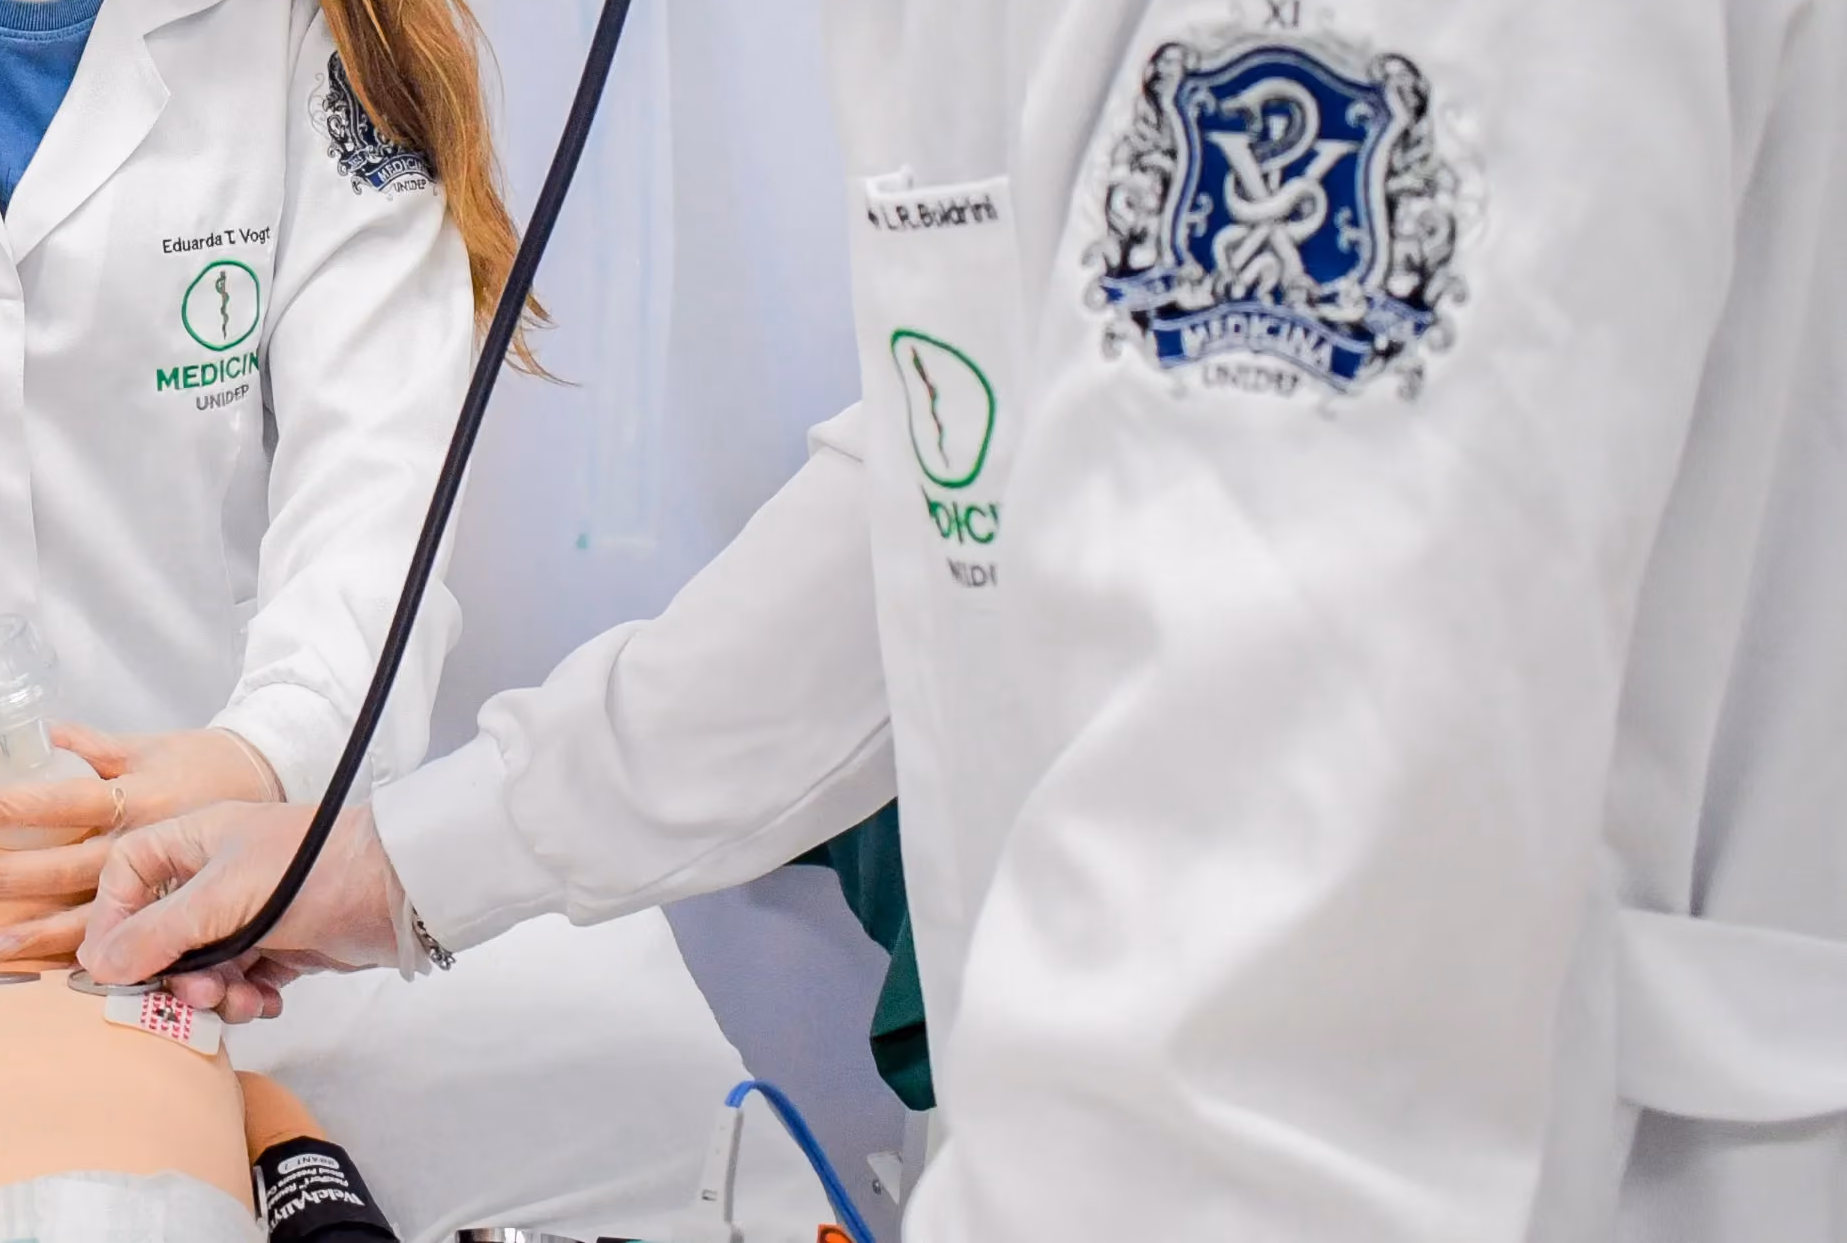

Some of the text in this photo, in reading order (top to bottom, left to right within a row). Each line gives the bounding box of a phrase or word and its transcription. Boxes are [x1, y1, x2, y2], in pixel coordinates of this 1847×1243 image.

[162, 232, 223, 253] Eduarda
[238, 225, 271, 244] Vogt
[1181, 311, 1331, 374] MEDICINA
[156, 352, 260, 392] MEDICIN
[196, 384, 250, 411] UNIDEP
